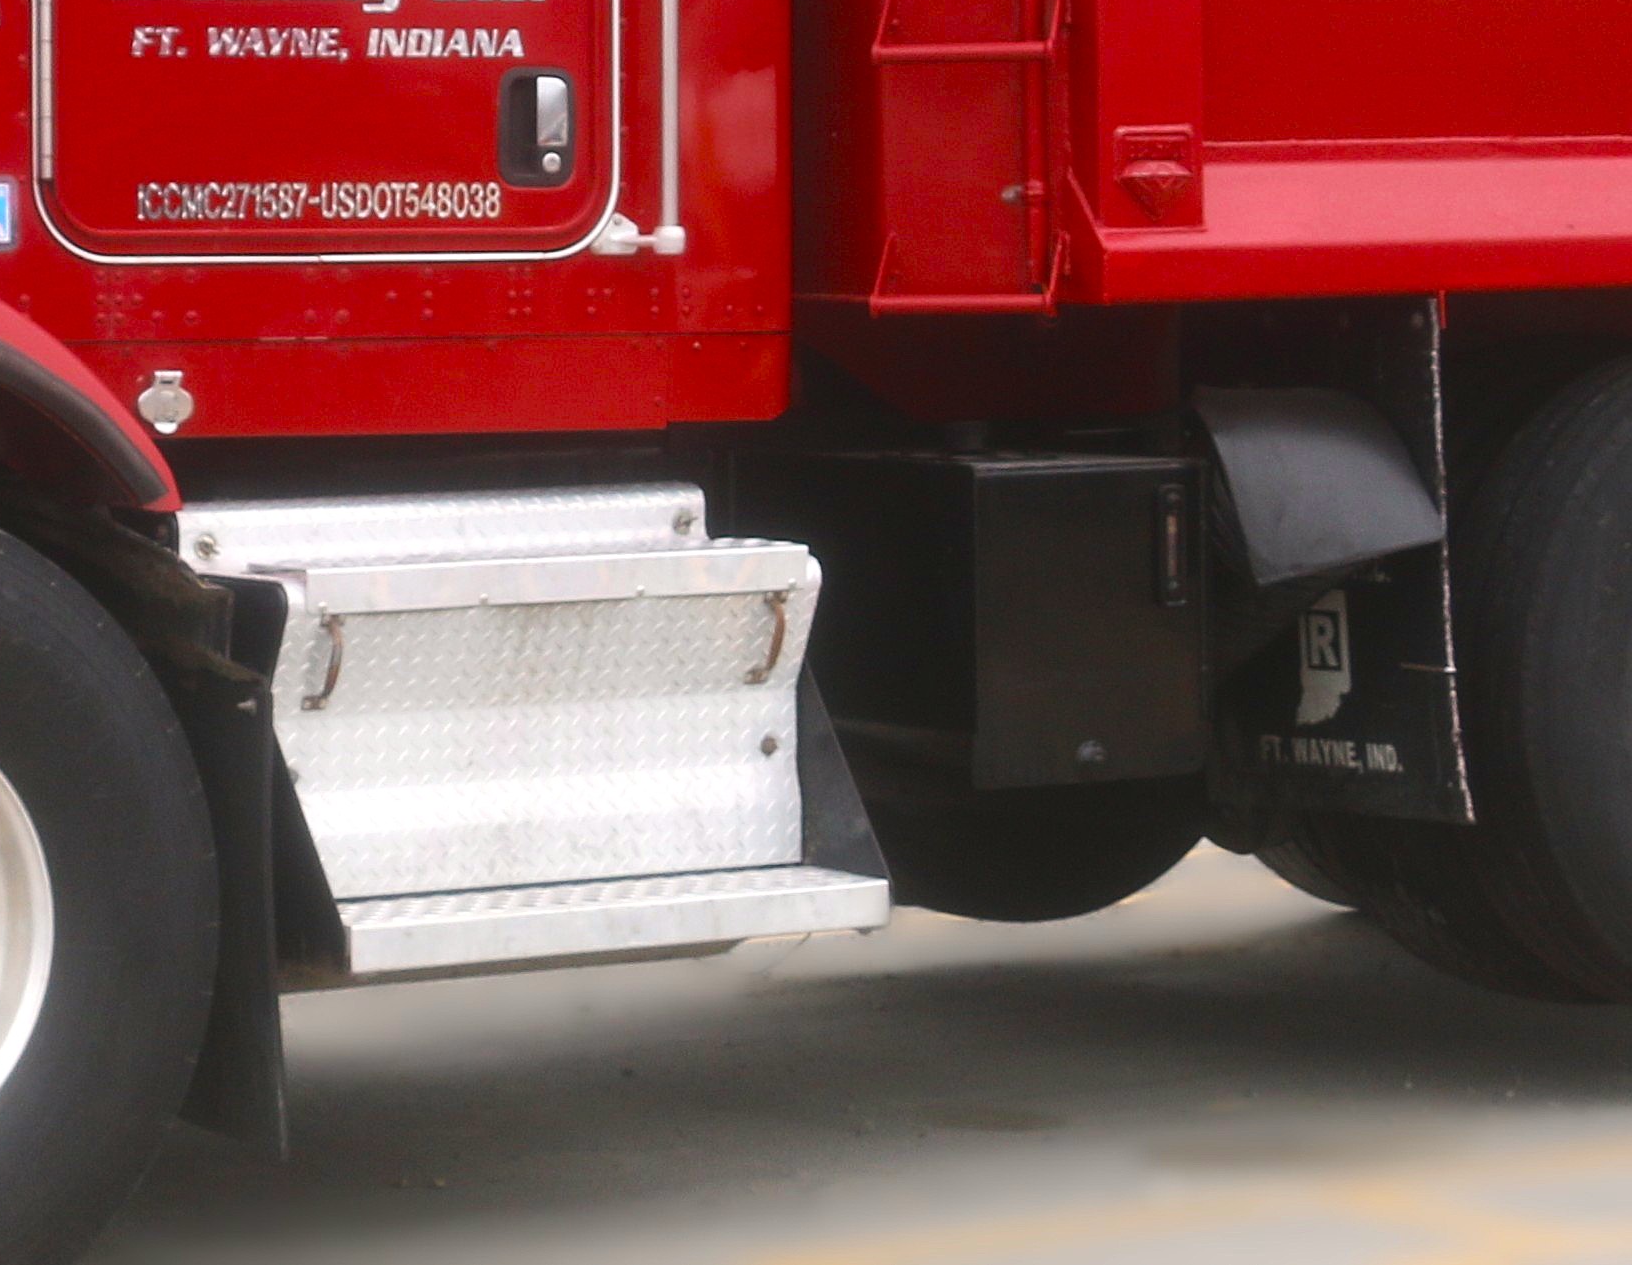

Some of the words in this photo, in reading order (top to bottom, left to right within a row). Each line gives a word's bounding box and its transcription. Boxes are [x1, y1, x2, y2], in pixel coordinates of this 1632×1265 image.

[130, 26, 189, 58] FT.
[207, 26, 352, 62] WAYNE,
[366, 28, 526, 59] INDIANA
[136, 182, 501, 221] ICCMC271587-USDOT548038
[1308, 612, 1338, 668] R
[1291, 737, 1364, 774] WAYNE,
